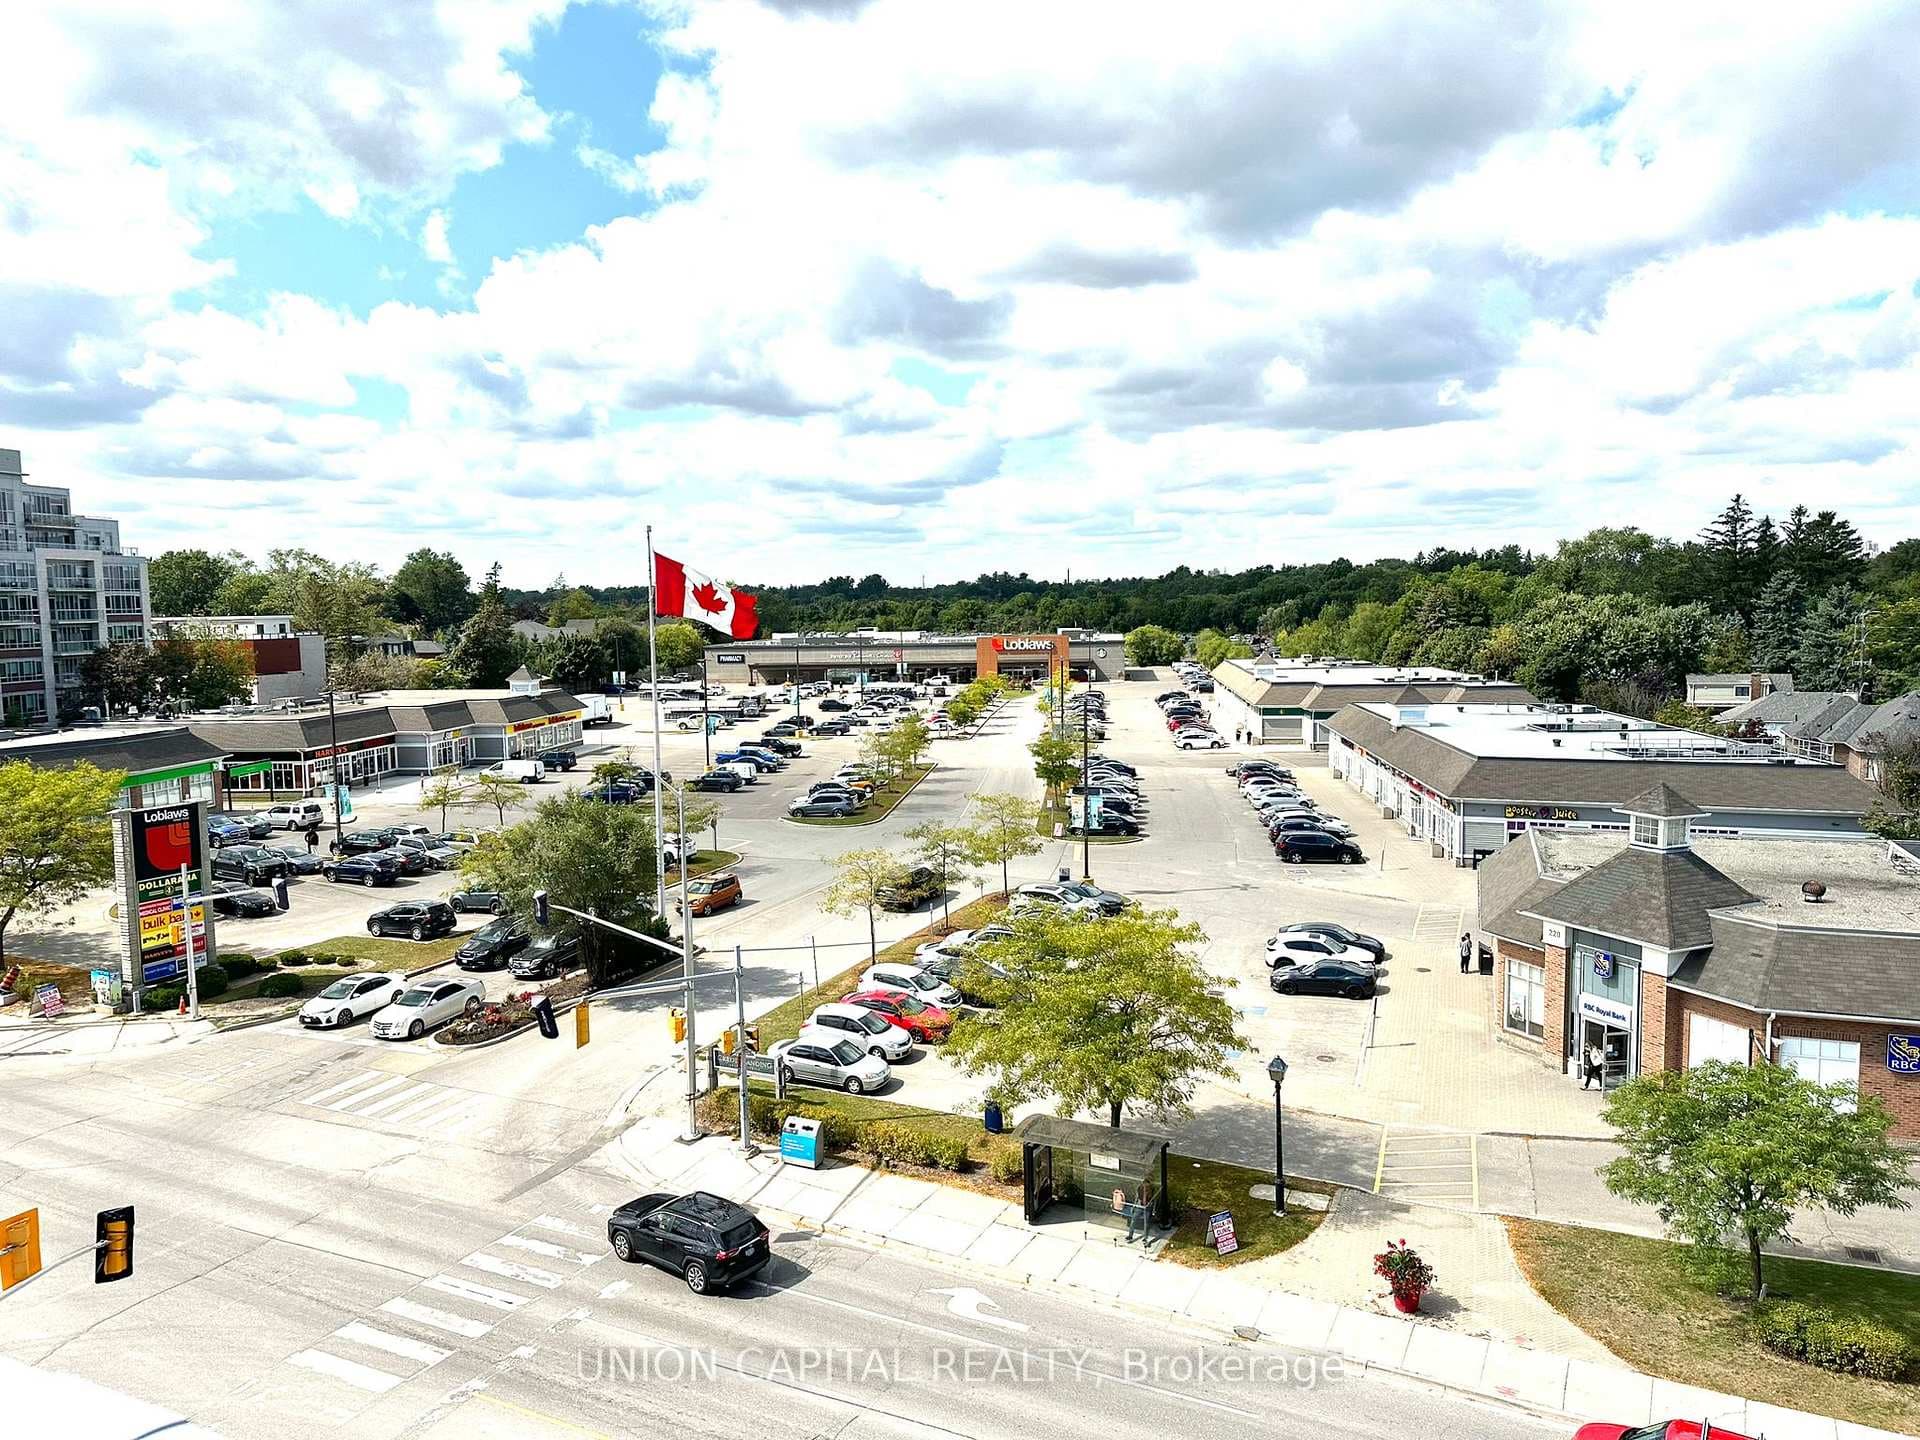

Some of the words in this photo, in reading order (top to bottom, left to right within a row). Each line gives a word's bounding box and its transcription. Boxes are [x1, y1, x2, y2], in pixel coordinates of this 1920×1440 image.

[1003, 637, 1054, 650] Loblaws
[143, 808, 189, 823] Loblaws
[1505, 805, 1537, 818] Booster
[1551, 807, 1577, 820] Juice
[138, 872, 198, 892] DOLLARAA
[143, 916, 166, 930] bulk
[1548, 928, 1561, 938] 220
[1583, 1003, 1595, 1012] RBC
[1596, 1006, 1612, 1018] Royal
[1612, 1010, 1627, 1021] Bank
[1891, 1060, 1919, 1070] RBC
